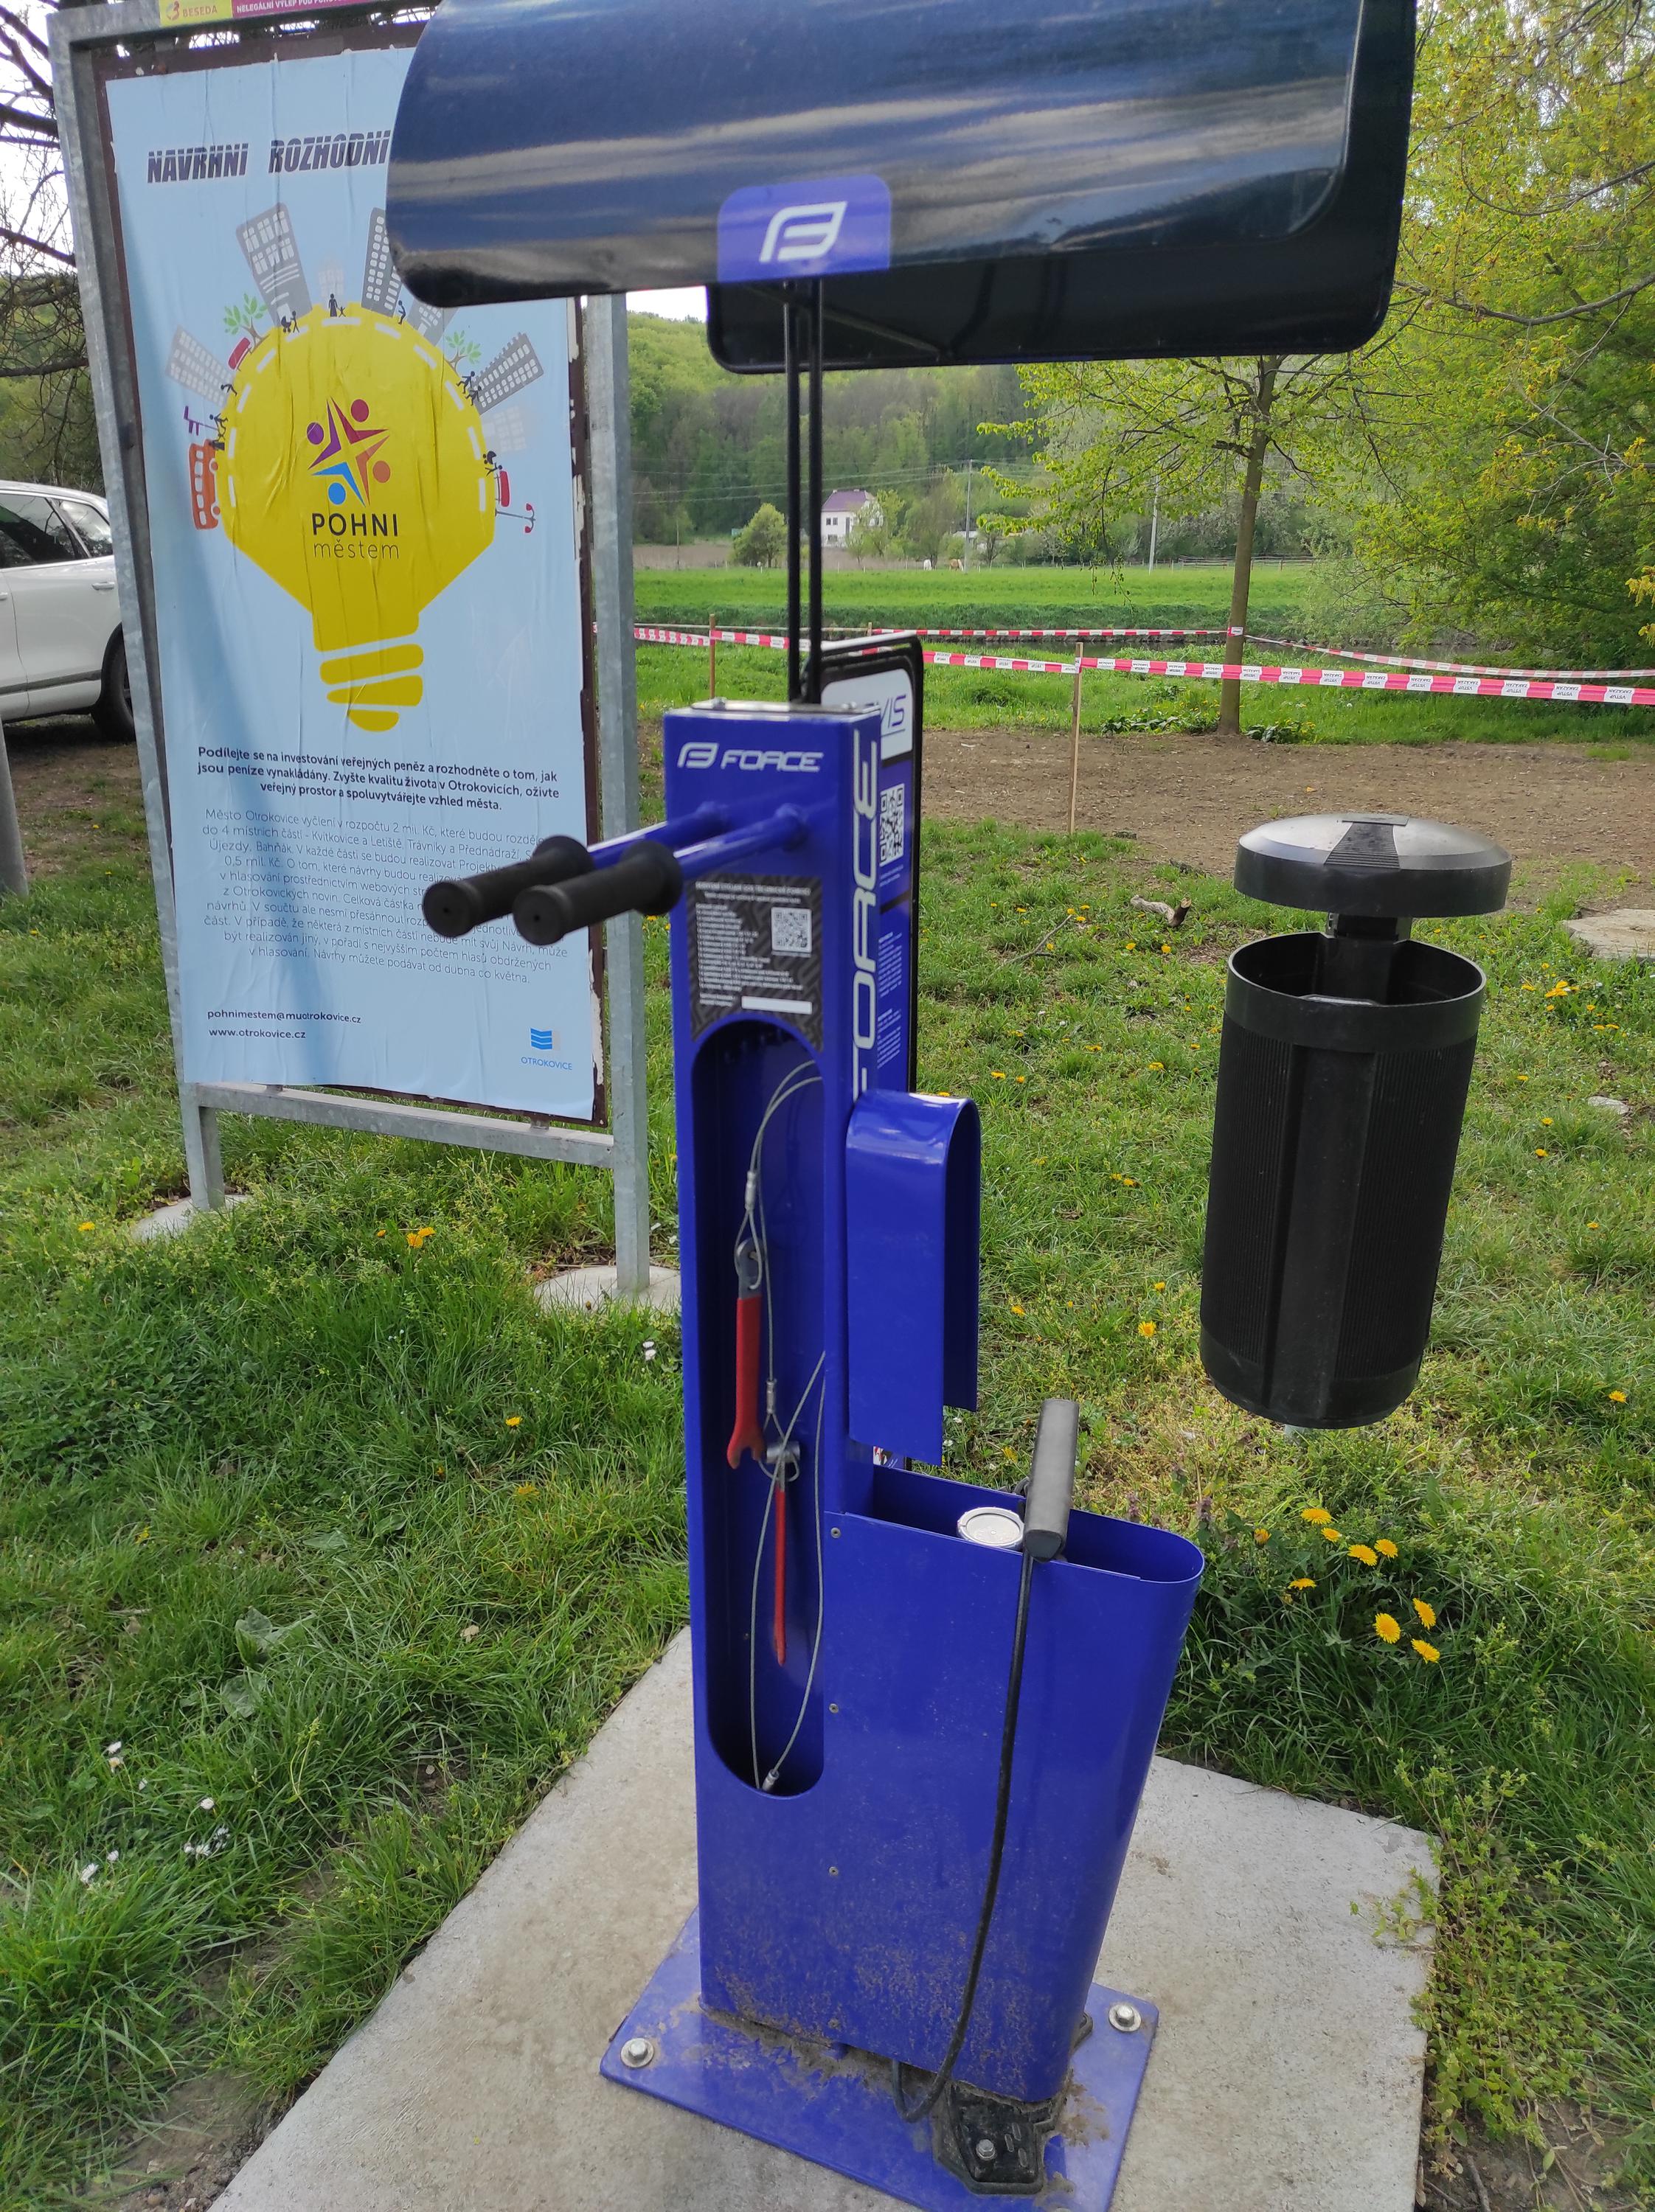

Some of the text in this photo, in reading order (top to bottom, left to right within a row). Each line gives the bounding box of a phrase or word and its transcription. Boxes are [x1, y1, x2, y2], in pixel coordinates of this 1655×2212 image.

[182, 5, 218, 18] BESEDA
[148, 130, 392, 184] NAVRHNI ROZHODNI
[312, 512, 399, 537] POHNI
[313, 540, 400, 560] městem
[198, 746, 558, 783] Podílejte se na investování veřejných peněz a rozhodněte o tom, jak
[720, 749, 825, 773] FORCE
[198, 762, 559, 799] jsou peníze vynakládány. Zvyšte kvalitu života v Otrokovicích, oživte
[260, 782, 502, 810] veřejný prostor a spoluvytvářejte vzhled města.
[206, 810, 242, 821] Město
[245, 811, 299, 824] Otrokovice
[301, 815, 335, 827] vyčlení
[338, 819, 342, 827] v
[345, 820, 389, 832] rozpočtu
[392, 822, 399, 832] 2
[422, 825, 437, 838] Kč,
[440, 827, 465, 839] které
[468, 830, 502, 842] budou
[506, 834, 544, 846] rozděle
[202, 824, 218, 835] do
[221, 825, 229, 835] 4
[233, 826, 279, 838] místních
[280, 828, 302, 840] částí
[312, 830, 359, 844] Kvítkovice
[362, 837, 367, 845] a
[371, 835, 404, 849] Letiště,
[407, 838, 445, 855] Trávníky
[450, 845, 455, 853] a
[459, 844, 521, 861] Přednádraží,
[224, 856, 242, 868] 0,5
[286, 858, 295, 869] O
[298, 860, 320, 872] tom,
[323, 860, 347, 873] které
[350, 864, 381, 879] návrhy
[384, 867, 416, 880] budou
[296, 844, 302, 854] V
[305, 844, 333, 857] každé
[336, 847, 358, 860] části
[361, 852, 372, 860] se
[375, 851, 406, 864] budou
[409, 856, 455, 869] realizovat
[220, 872, 226, 880] v
[230, 869, 280, 882] hlasování
[283, 874, 357, 889] prostřednictvím
[360, 881, 410, 896] webových
[223, 888, 229, 896] z
[233, 885, 308, 900] Otrokovických
[343, 893, 381, 907] Celková
[384, 897, 414, 910] částka
[252, 900, 260, 911] V
[264, 902, 299, 913] součtu
[302, 903, 316, 914] ale
[319, 907, 347, 917] nesmí
[350, 908, 404, 923] přesáhnout
[235, 915, 242, 926] V
[246, 916, 289, 929] případě,
[292, 918, 304, 929] že
[307, 919, 341, 932] některá
[345, 925, 350, 933] z
[353, 923, 393, 937] místních
[395, 927, 417, 939] částí
[461, 936, 476, 947] mít
[480, 938, 499, 952] svůj
[502, 939, 534, 955] Návrh,
[538, 945, 567, 956] může
[224, 930, 242, 943] být
[245, 931, 298, 942] realizován
[301, 933, 320, 947] jiný,
[323, 937, 329, 945] v
[332, 936, 361, 948] pořadí
[364, 941, 369, 949] s
[372, 941, 417, 954] nejvyšším
[420, 946, 458, 959] počtem
[490, 954, 551, 971] obdržených
[249, 948, 255, 956] v
[313, 947, 345, 963] Návrhy
[349, 952, 384, 964] můžete
[386, 956, 426, 970] podávat
[429, 961, 441, 972] od
[444, 963, 475, 976] dubna
[209, 1029, 306, 1039] www.otrokovice.cz
[521, 1057, 572, 1070] OTROKOVICE
